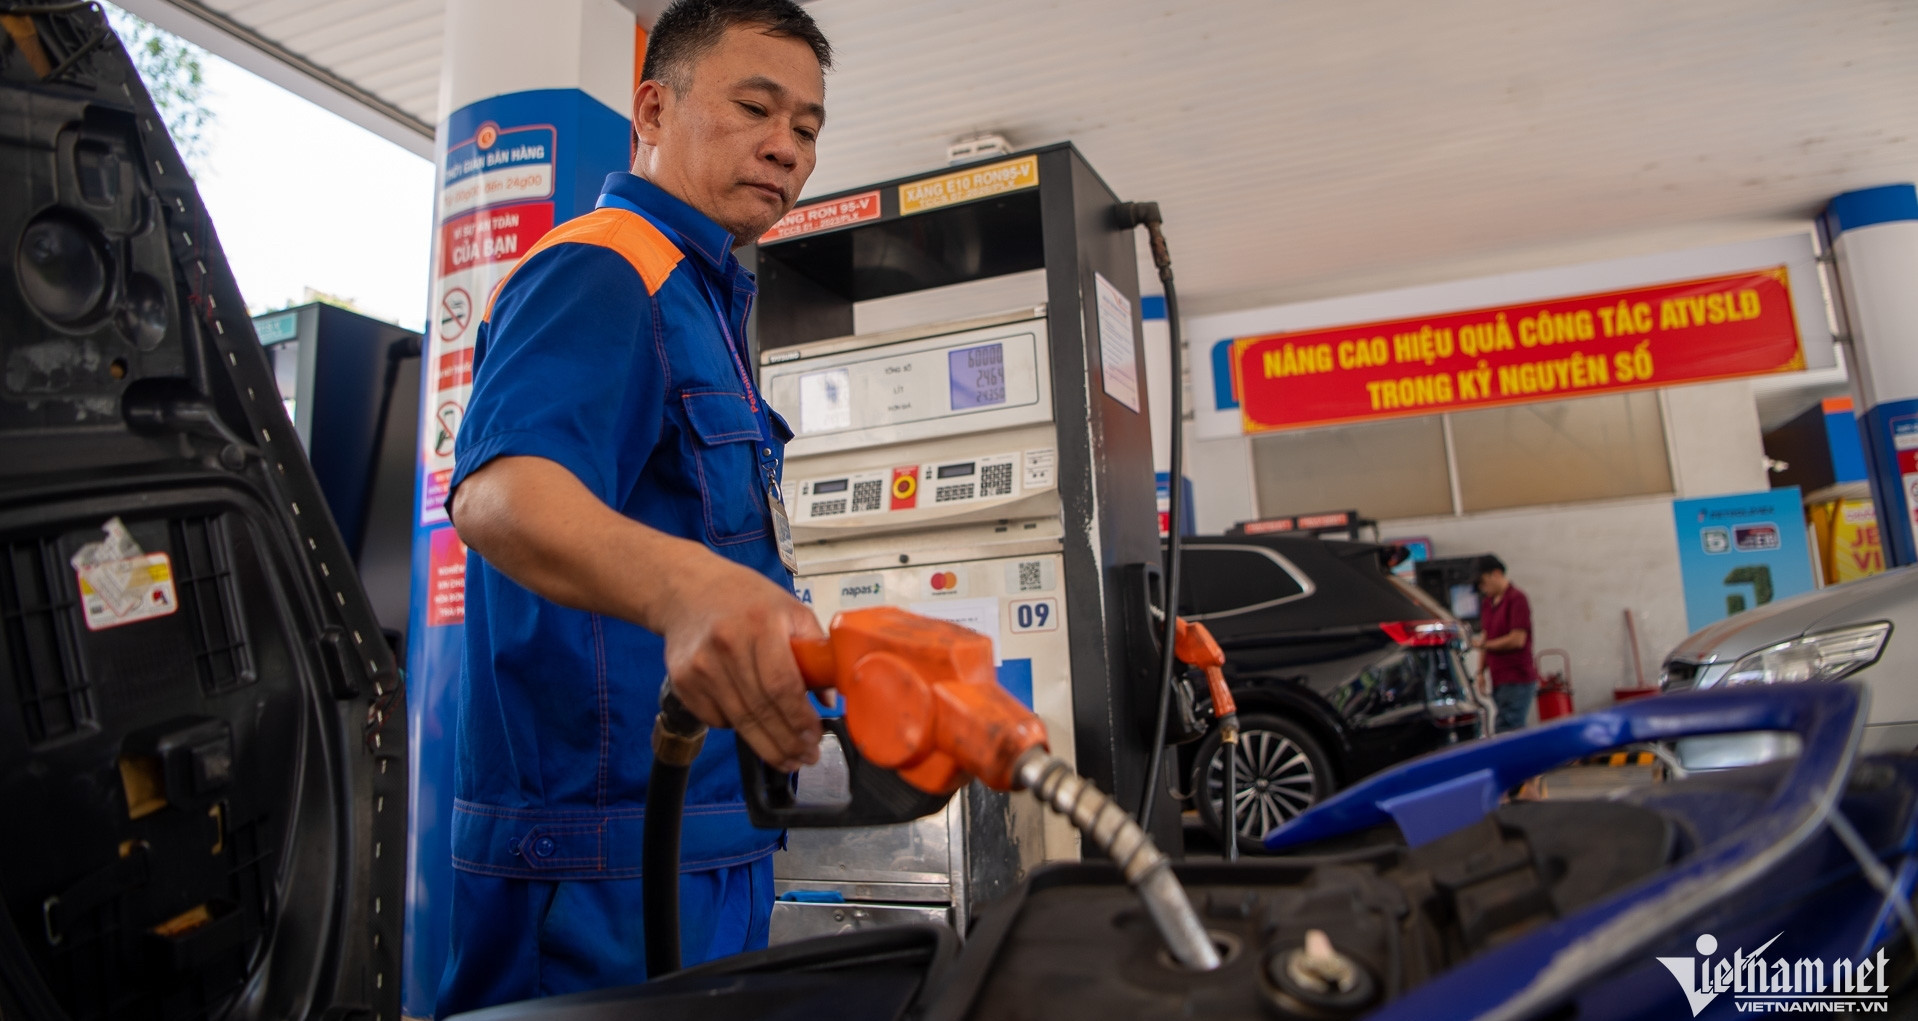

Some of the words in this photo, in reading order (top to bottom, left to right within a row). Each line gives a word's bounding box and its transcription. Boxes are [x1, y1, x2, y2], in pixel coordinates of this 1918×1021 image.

[464, 156, 485, 174] GIAN
[511, 144, 545, 161] HÀNG
[947, 176, 970, 191] E10
[492, 212, 519, 230] TOÀN
[808, 205, 838, 221] RON
[840, 199, 870, 214] 95-V
[453, 238, 480, 266] CỦA
[482, 233, 517, 259] BẠN
[1263, 343, 1334, 378] NÂNG
[1337, 336, 1389, 370] CAO
[1393, 325, 1454, 366] HIỆU
[1458, 312, 1514, 357] QUẢ
[1518, 310, 1595, 348] CÔNG
[1597, 299, 1653, 338] TÁC
[1660, 289, 1762, 331] ATVSLĐ
[1366, 372, 1454, 411] TRONG
[1457, 359, 1492, 400] KỶ
[1497, 351, 1610, 397] NGUYÊN
[1613, 339, 1654, 382] SỐ
[842, 584, 872, 598] napas
[1018, 603, 1049, 628] 09
